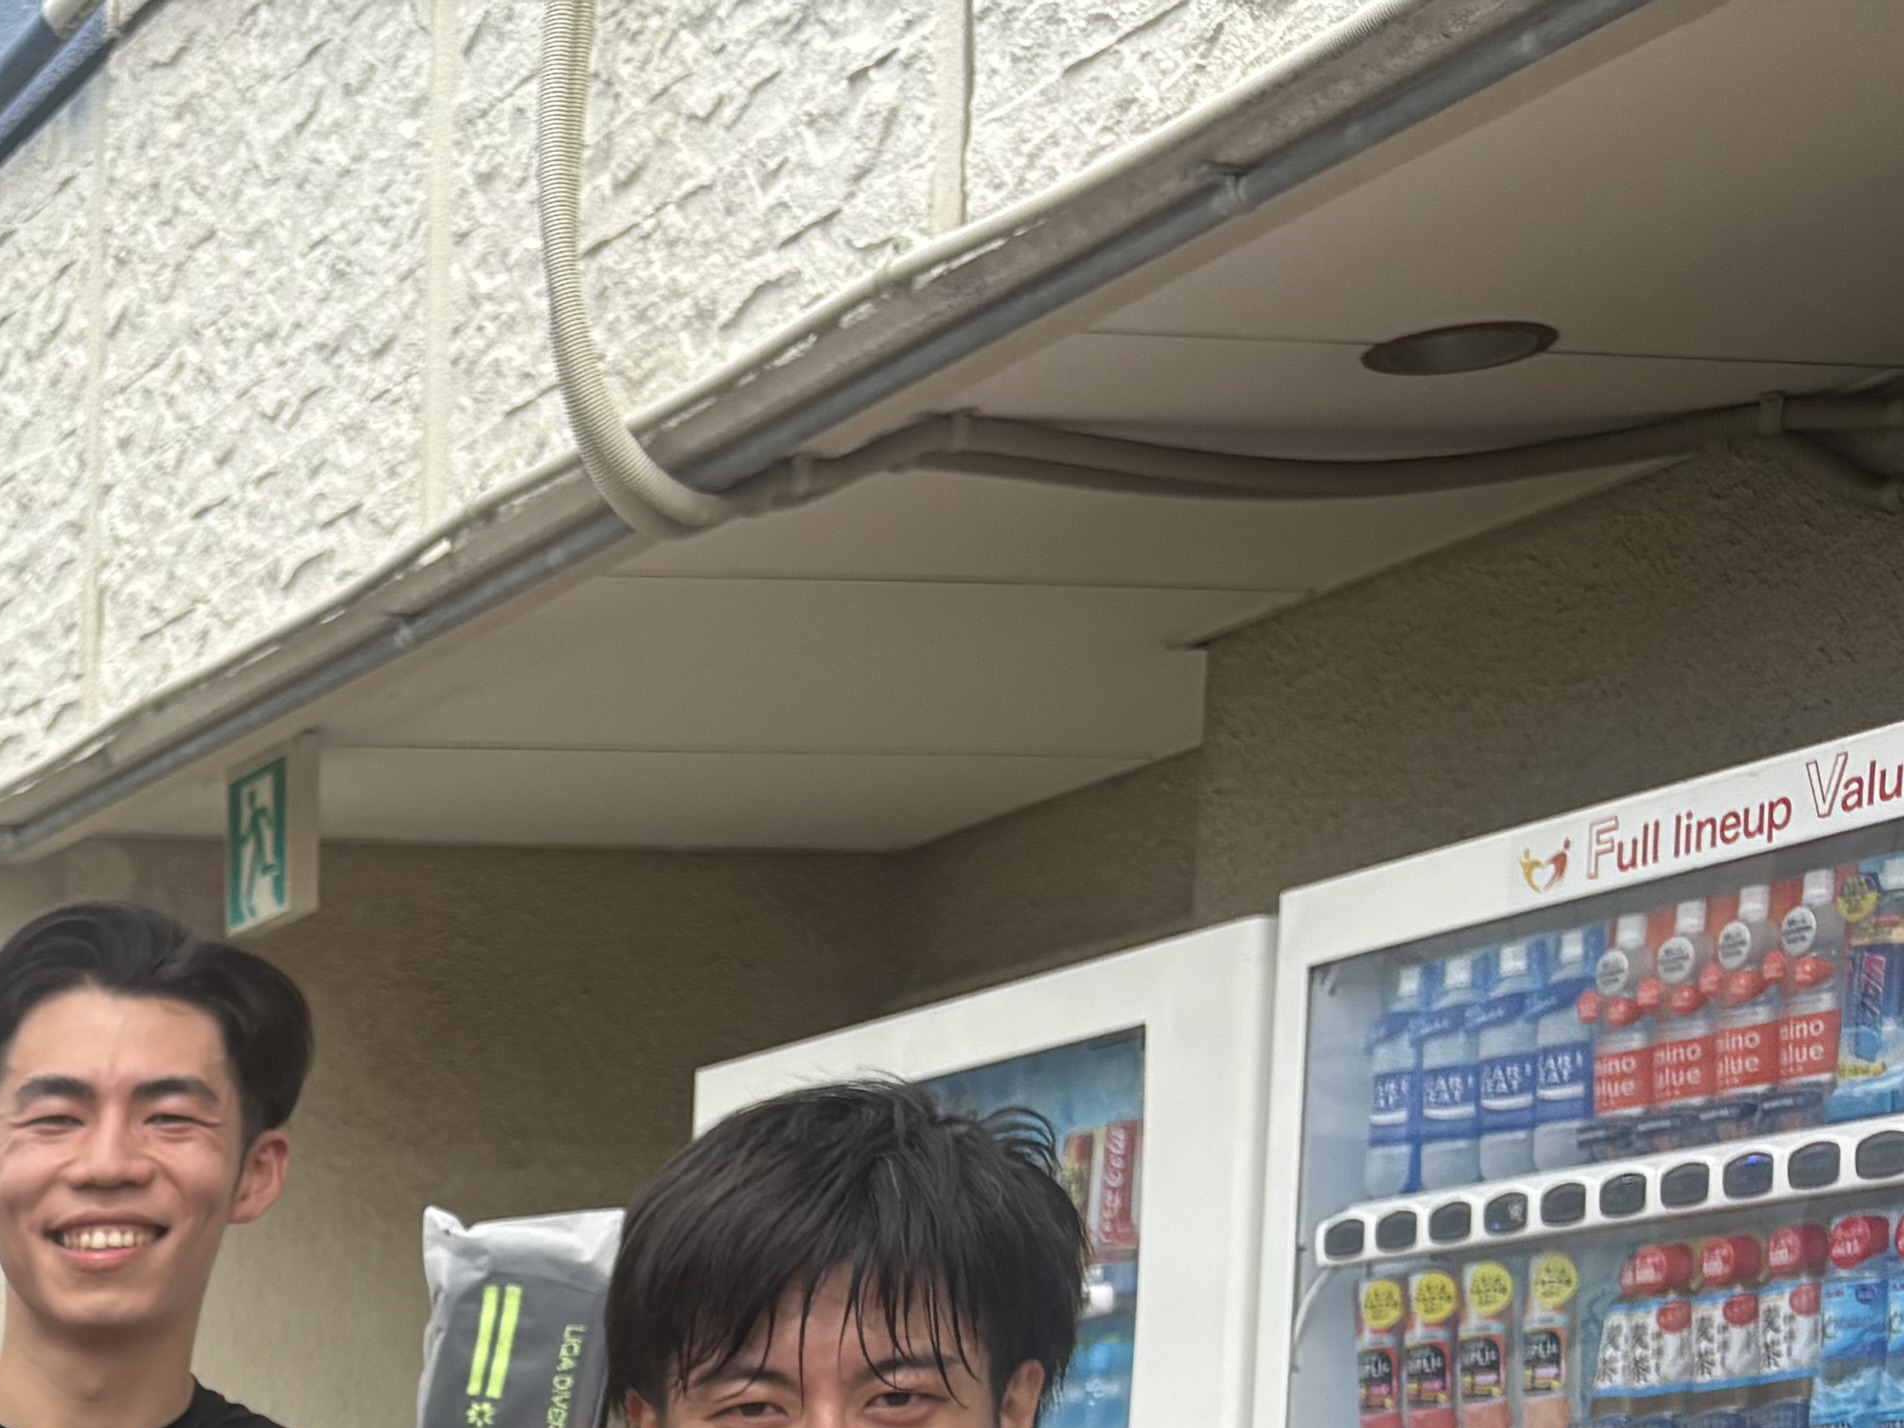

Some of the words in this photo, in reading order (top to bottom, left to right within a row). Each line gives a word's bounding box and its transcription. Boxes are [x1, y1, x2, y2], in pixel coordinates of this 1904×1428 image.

[1586, 815, 1660, 880] Full
[1673, 795, 1793, 859] lineup
[1805, 750, 1904, 820] Valu
